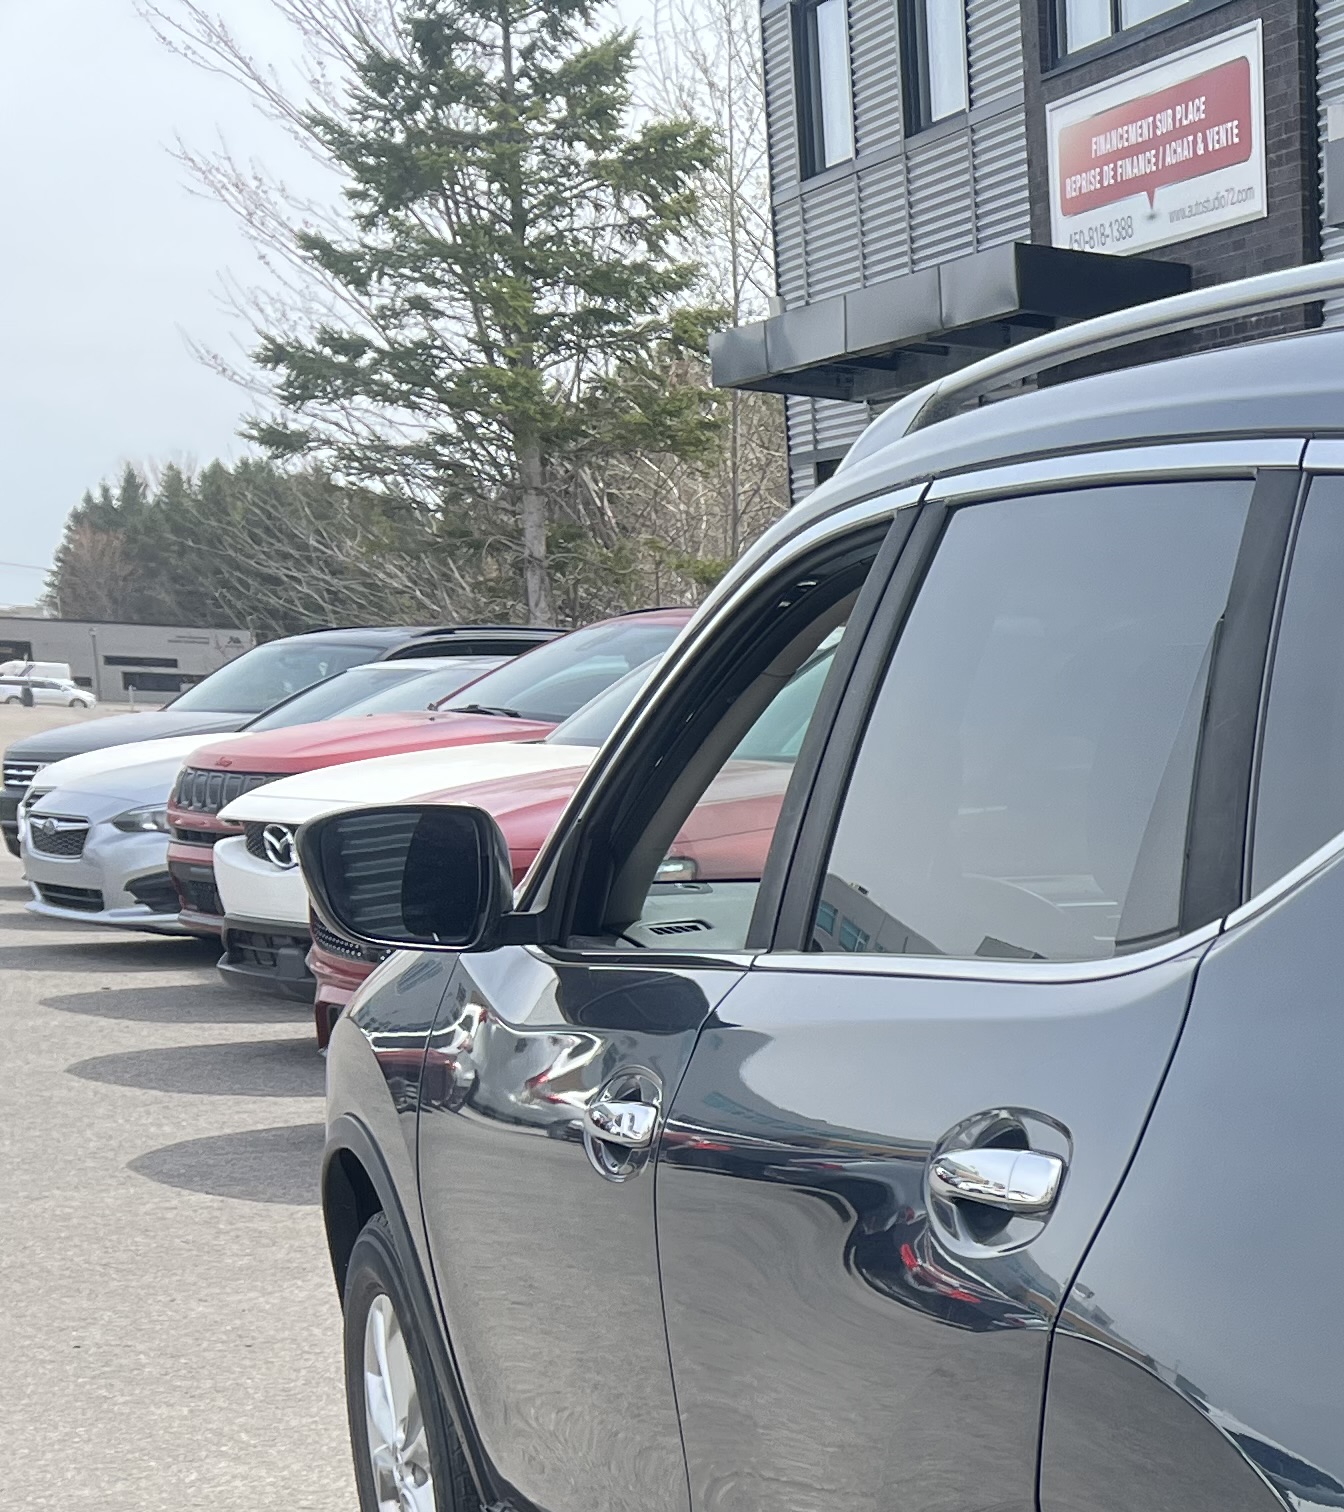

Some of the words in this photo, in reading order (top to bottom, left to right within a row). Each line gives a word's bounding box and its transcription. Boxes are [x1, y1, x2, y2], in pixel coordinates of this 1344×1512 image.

[1065, 166, 1101, 200] REPRISE
[1103, 163, 1115, 185] DE
[1117, 149, 1157, 183] FINANCE
[1165, 136, 1194, 166] ACHAT
[1196, 132, 1205, 155] &
[1206, 120, 1240, 152] VENTE
[1091, 117, 1154, 159] FINANCEMENT
[1155, 109, 1173, 136] SUR
[1175, 96, 1206, 129] PLACE
